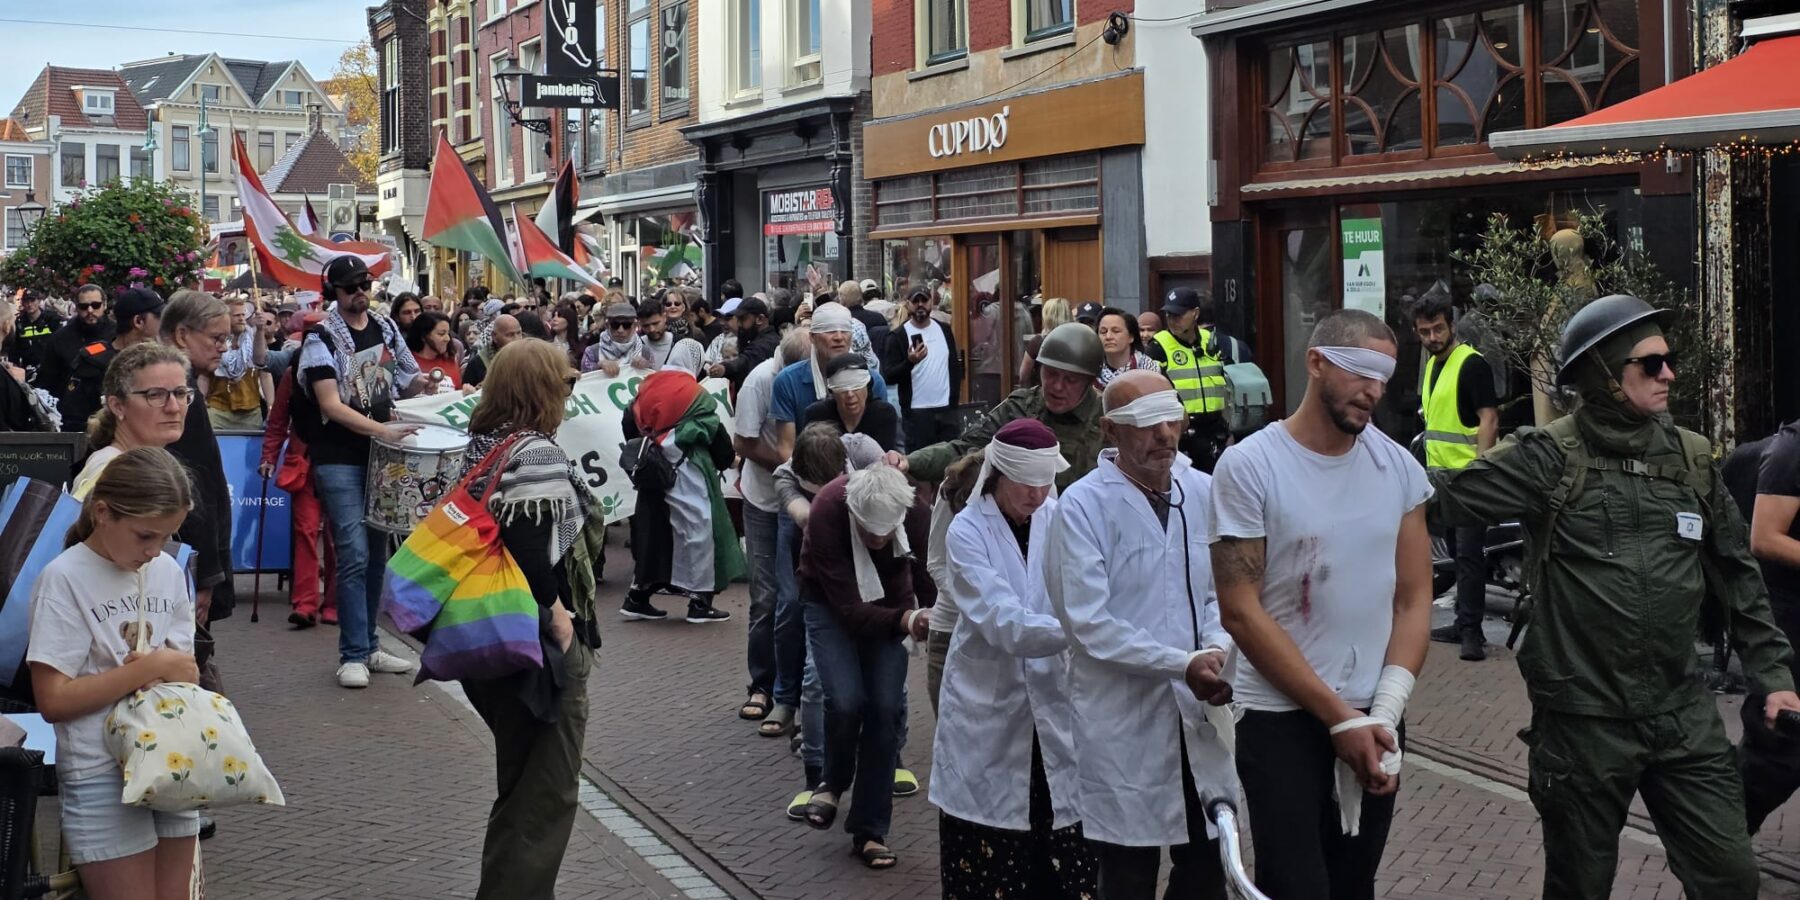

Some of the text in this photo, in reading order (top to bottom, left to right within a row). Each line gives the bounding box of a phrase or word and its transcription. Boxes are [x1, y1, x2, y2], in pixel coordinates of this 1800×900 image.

[536, 82, 594, 99] jambelles
[1343, 229, 1380, 243] TE HUUR
[1224, 278, 1237, 302] 18
[237, 497, 285, 506] VINTAGE
[91, 600, 119, 623] LOS
